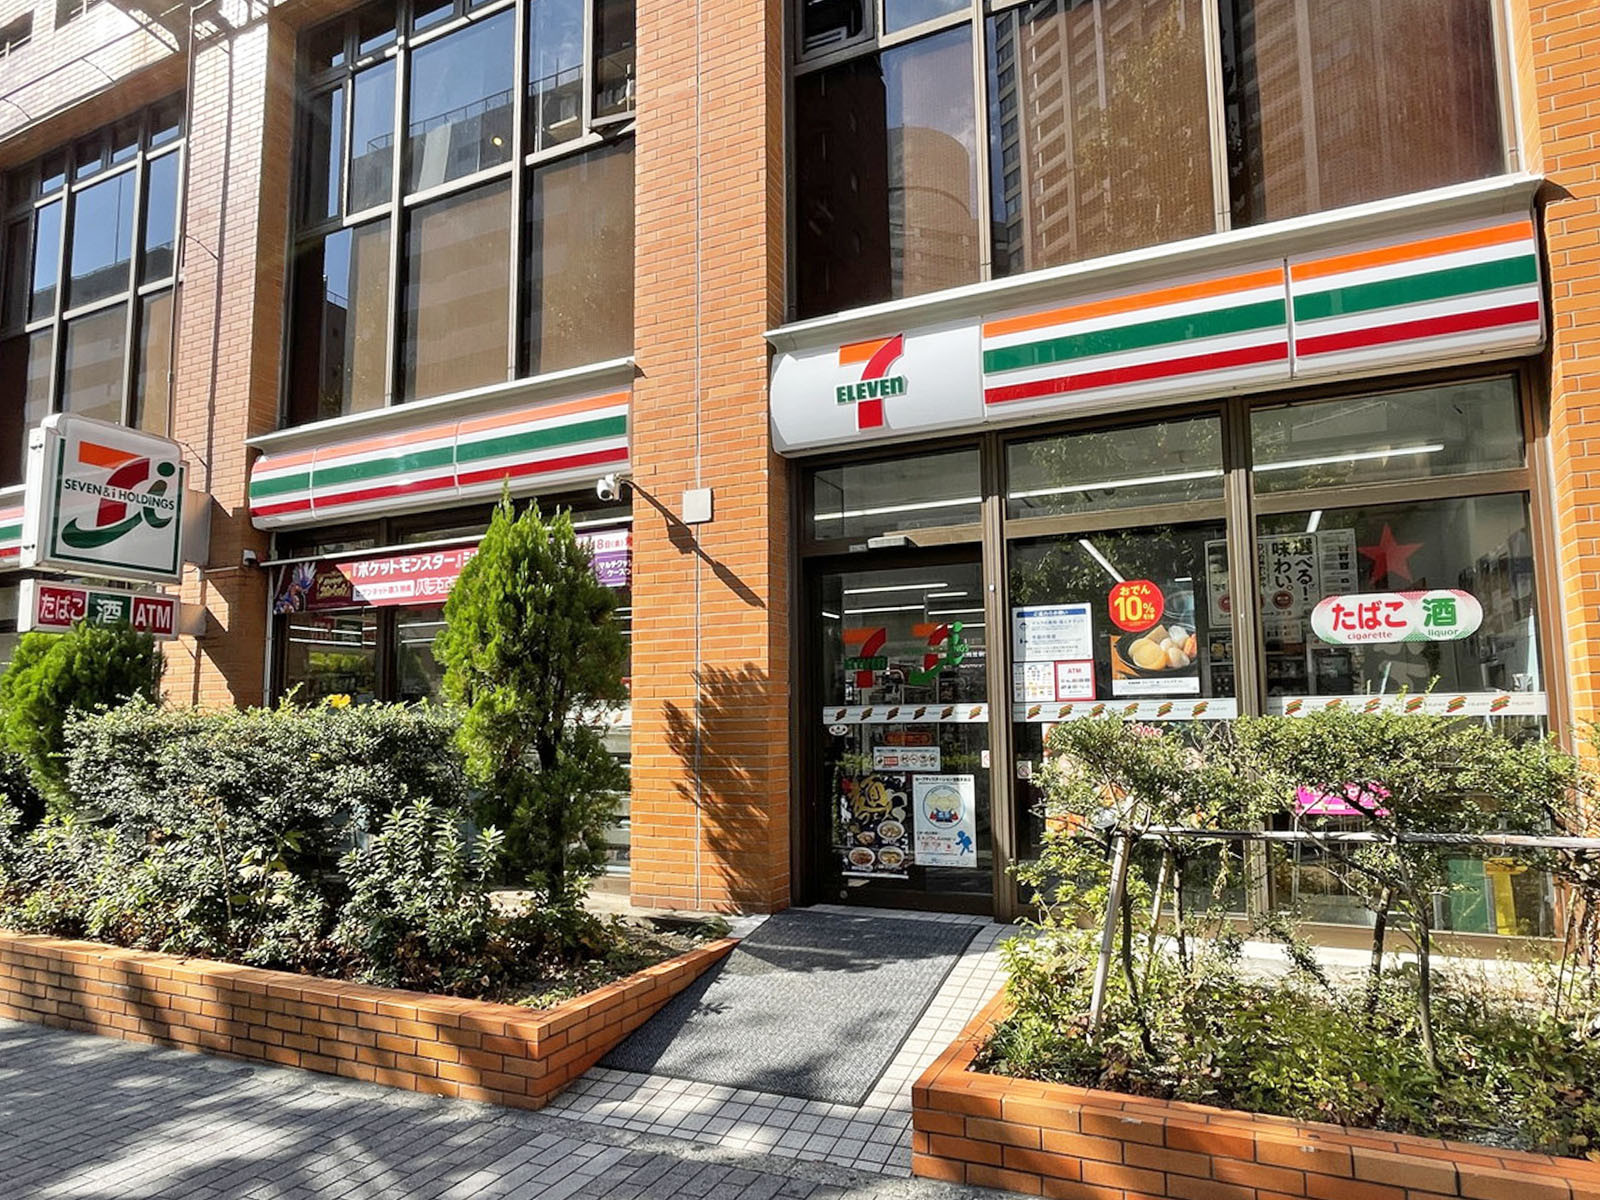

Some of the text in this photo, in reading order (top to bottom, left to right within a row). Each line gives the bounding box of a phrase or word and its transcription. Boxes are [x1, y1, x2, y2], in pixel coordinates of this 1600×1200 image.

[118, 490, 175, 510] HOLDINGS
[1119, 584, 1151, 596] おでん
[40, 593, 171, 630] たばこ 酒 ATM
[1332, 600, 1408, 631] たばこ
[1422, 597, 1457, 627] 酒
[1347, 628, 1459, 640] cigarette liquor
